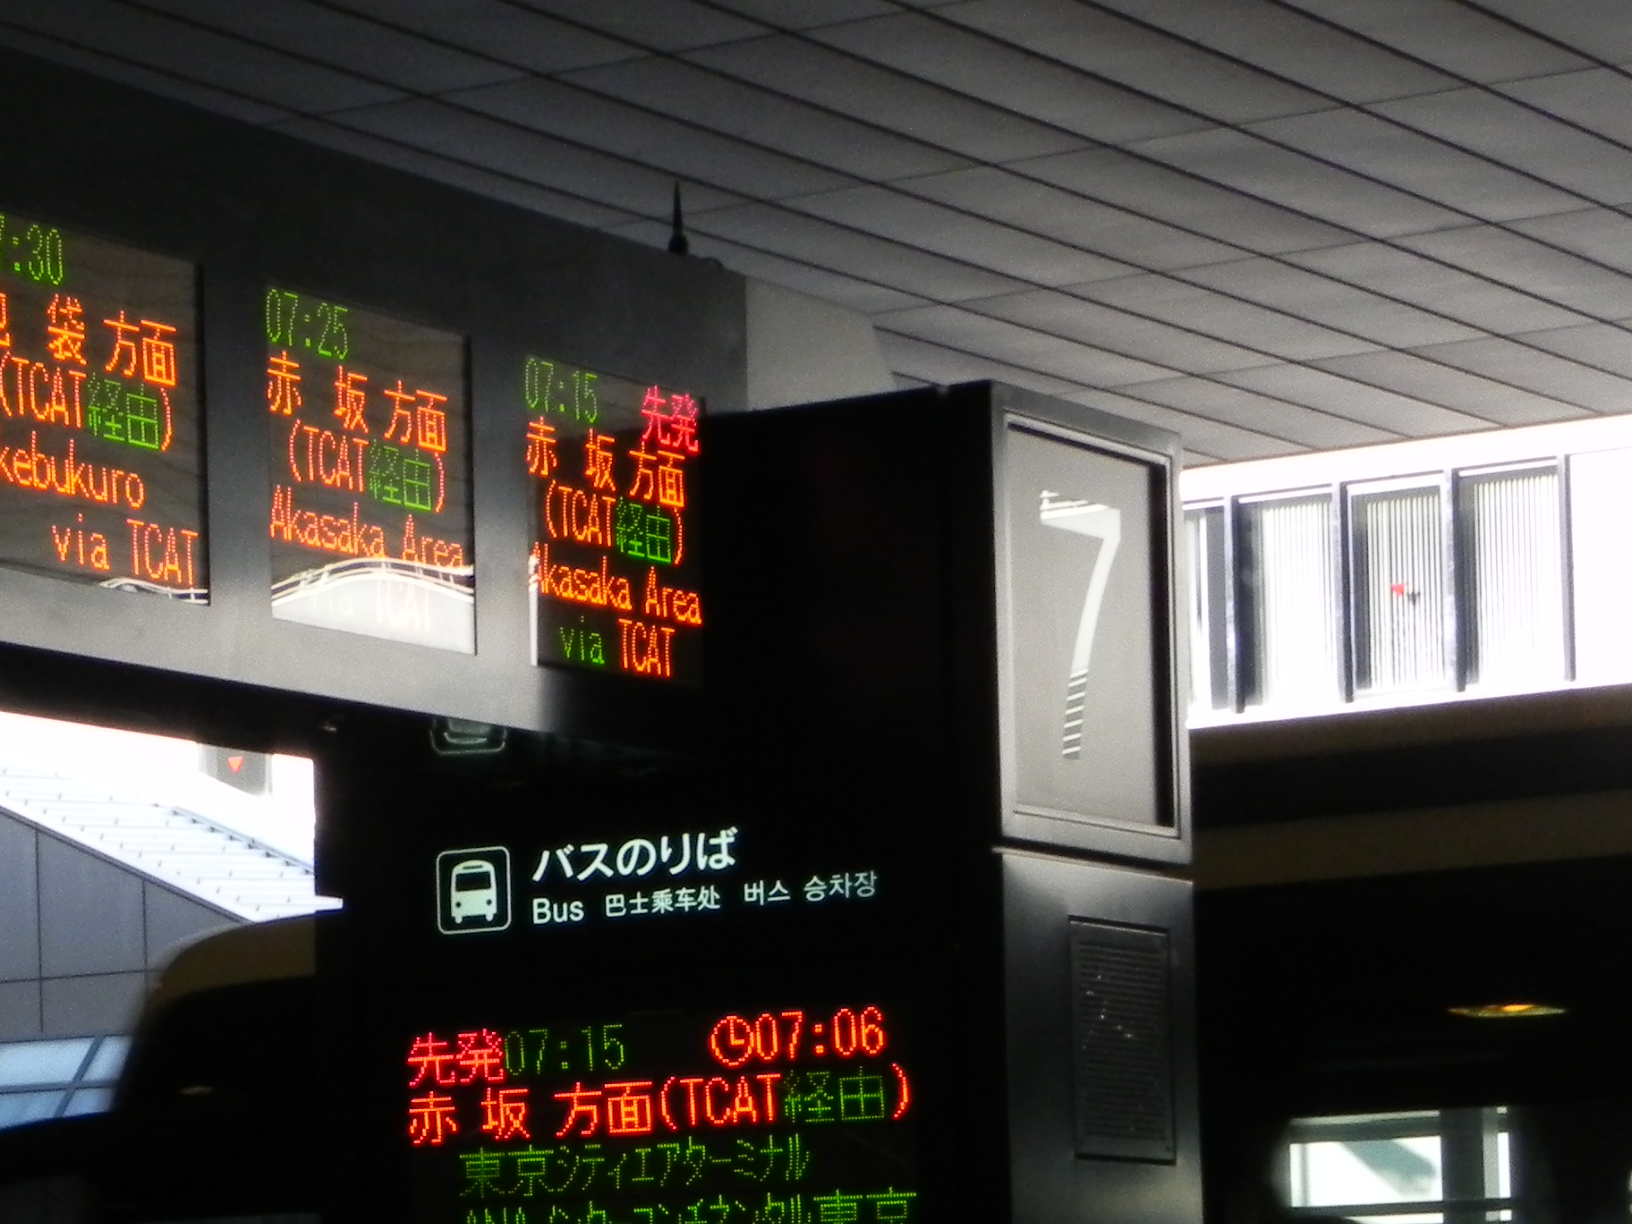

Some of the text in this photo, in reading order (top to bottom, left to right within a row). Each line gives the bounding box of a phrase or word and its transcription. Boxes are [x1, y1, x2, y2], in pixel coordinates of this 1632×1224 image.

[265, 288, 348, 360] 07:25
[525, 358, 598, 424] 07:15
[642, 385, 699, 452] 先発
[52, 513, 199, 585] via TCAT
[270, 484, 464, 570] Akasaka Area
[645, 566, 703, 625] Area
[1039, 492, 1122, 762] 7
[560, 615, 676, 677] via TCAT
[532, 827, 738, 882] バスのりば
[532, 897, 585, 924] Bus
[743, 871, 879, 906] 버스 승차장
[755, 1006, 884, 1060] 07:06
